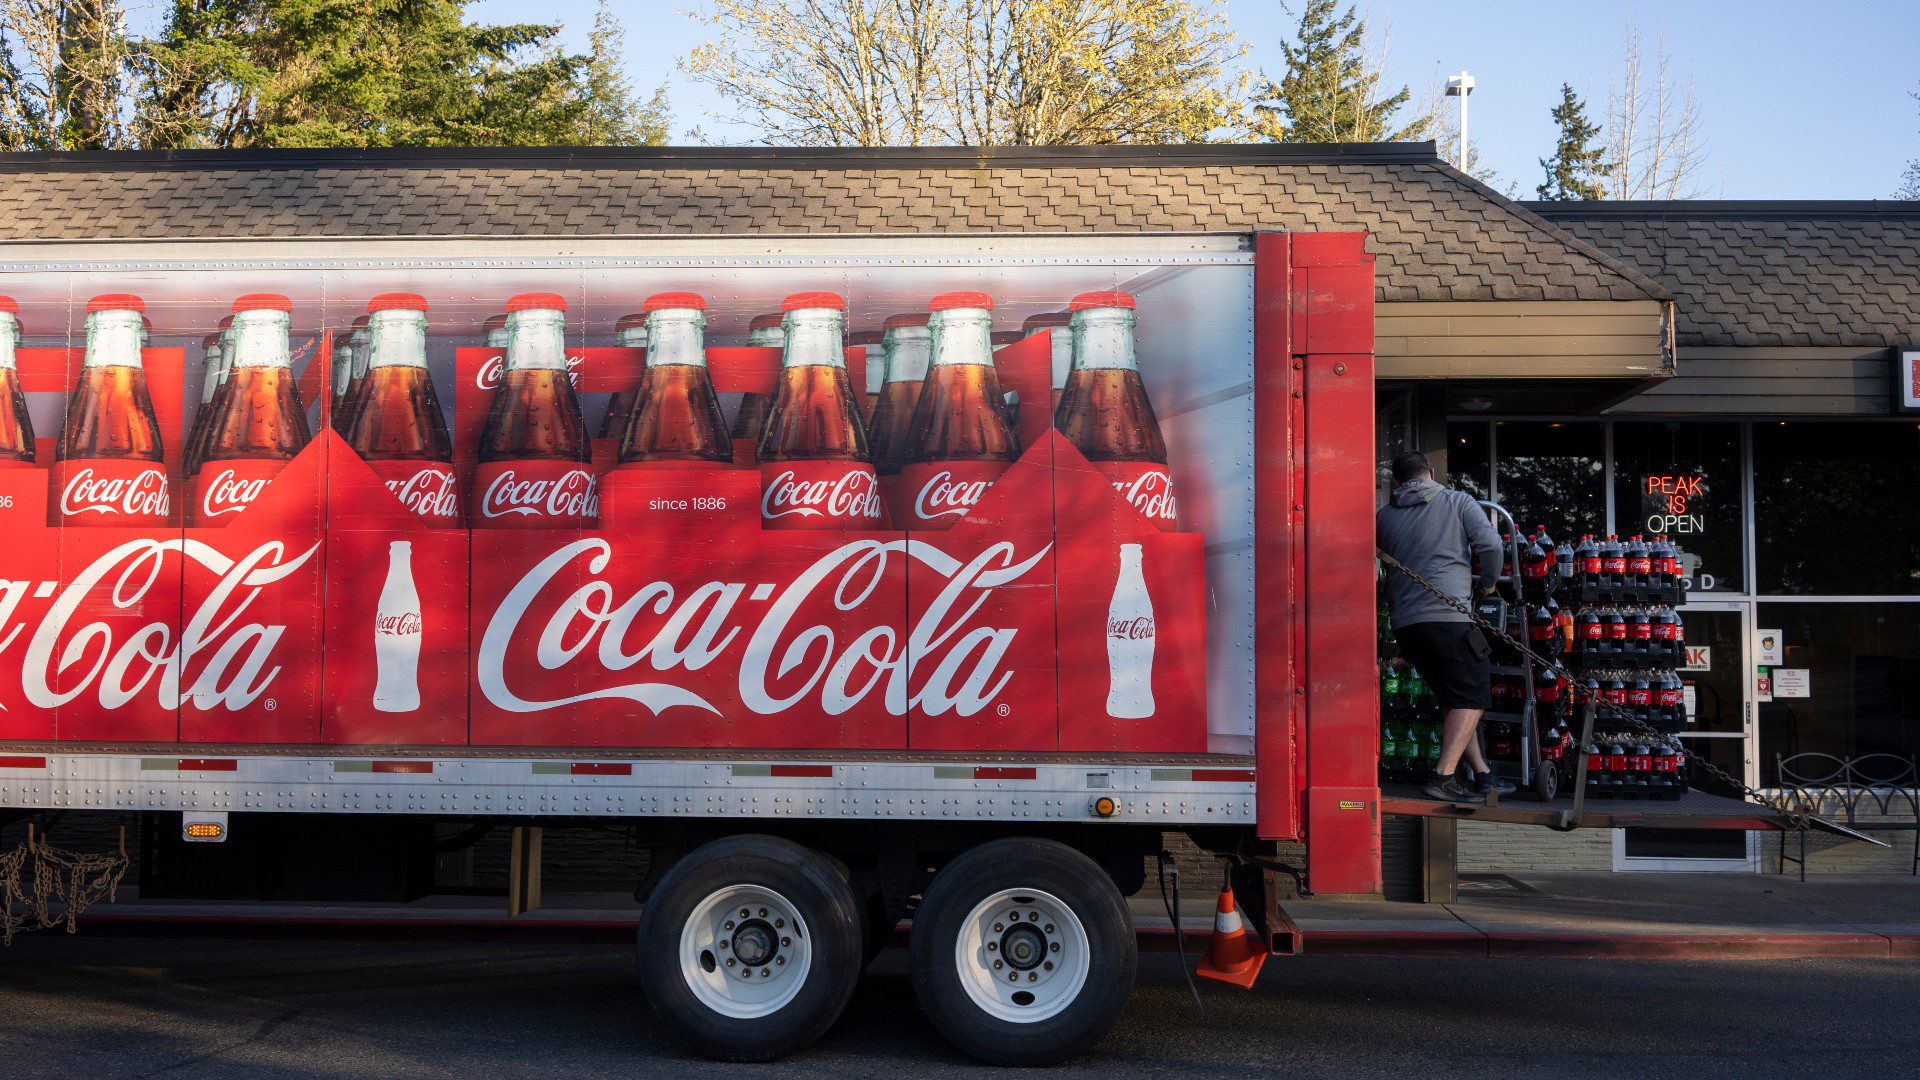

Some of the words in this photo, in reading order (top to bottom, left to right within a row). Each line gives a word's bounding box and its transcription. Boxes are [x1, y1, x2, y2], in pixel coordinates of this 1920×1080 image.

[60, 468, 170, 517] Coca-Cola
[482, 470, 599, 518] Coca-Cola
[761, 470, 881, 519] Coca-Cola
[1648, 476, 1703, 496] PEAK
[649, 497, 688, 510] since
[691, 497, 726, 510] 1886
[1669, 495, 1686, 514] IS
[1647, 514, 1704, 533] OPEN
[377, 612, 421, 636] Coca-Cola
[478, 538, 1053, 718] Coca-Cola
[1108, 616, 1154, 640] Coca-Cola
